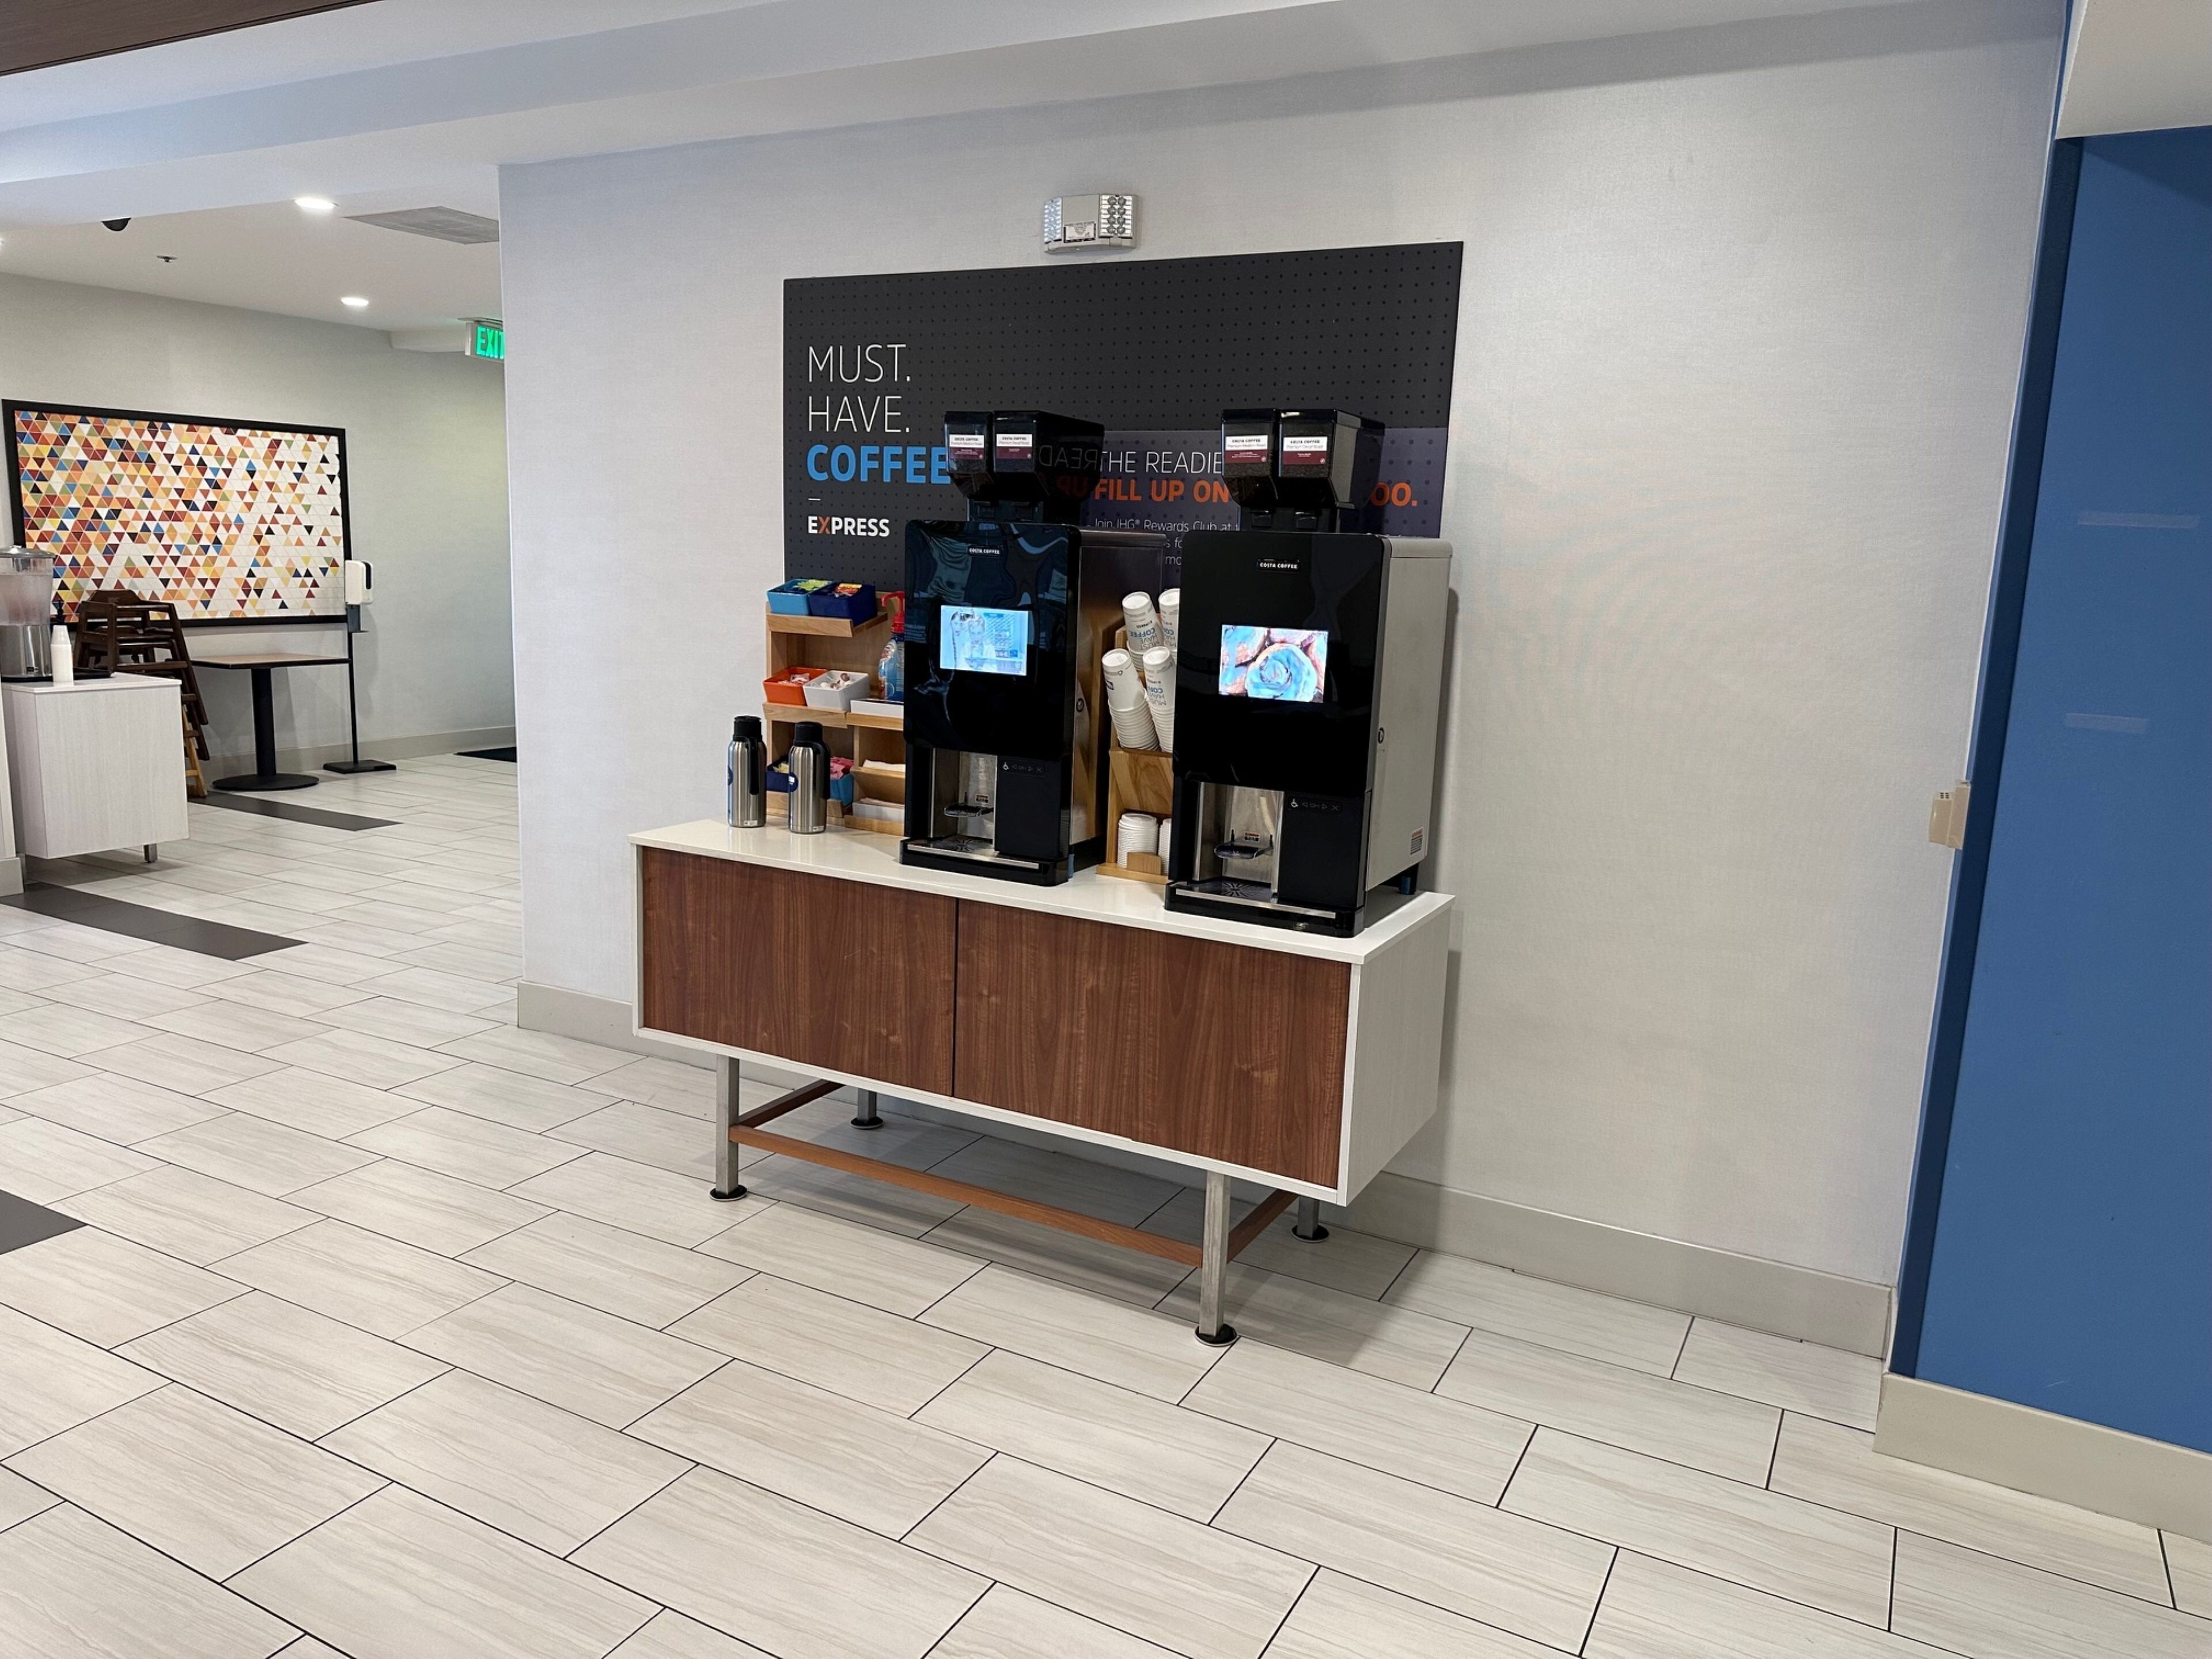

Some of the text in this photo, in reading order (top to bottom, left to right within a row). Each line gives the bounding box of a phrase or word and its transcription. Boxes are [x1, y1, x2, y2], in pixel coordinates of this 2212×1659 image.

[476, 326, 505, 359] EXIT
[809, 344, 911, 383] MUST.
[809, 395, 911, 433] HAVE.
[807, 444, 950, 484] COFFEE
[1094, 479, 1142, 501] FILL
[1151, 480, 1185, 502] UP
[1193, 480, 1229, 503] ON
[808, 516, 890, 537] EXPRESS
[1143, 519, 1188, 532] Rewards
